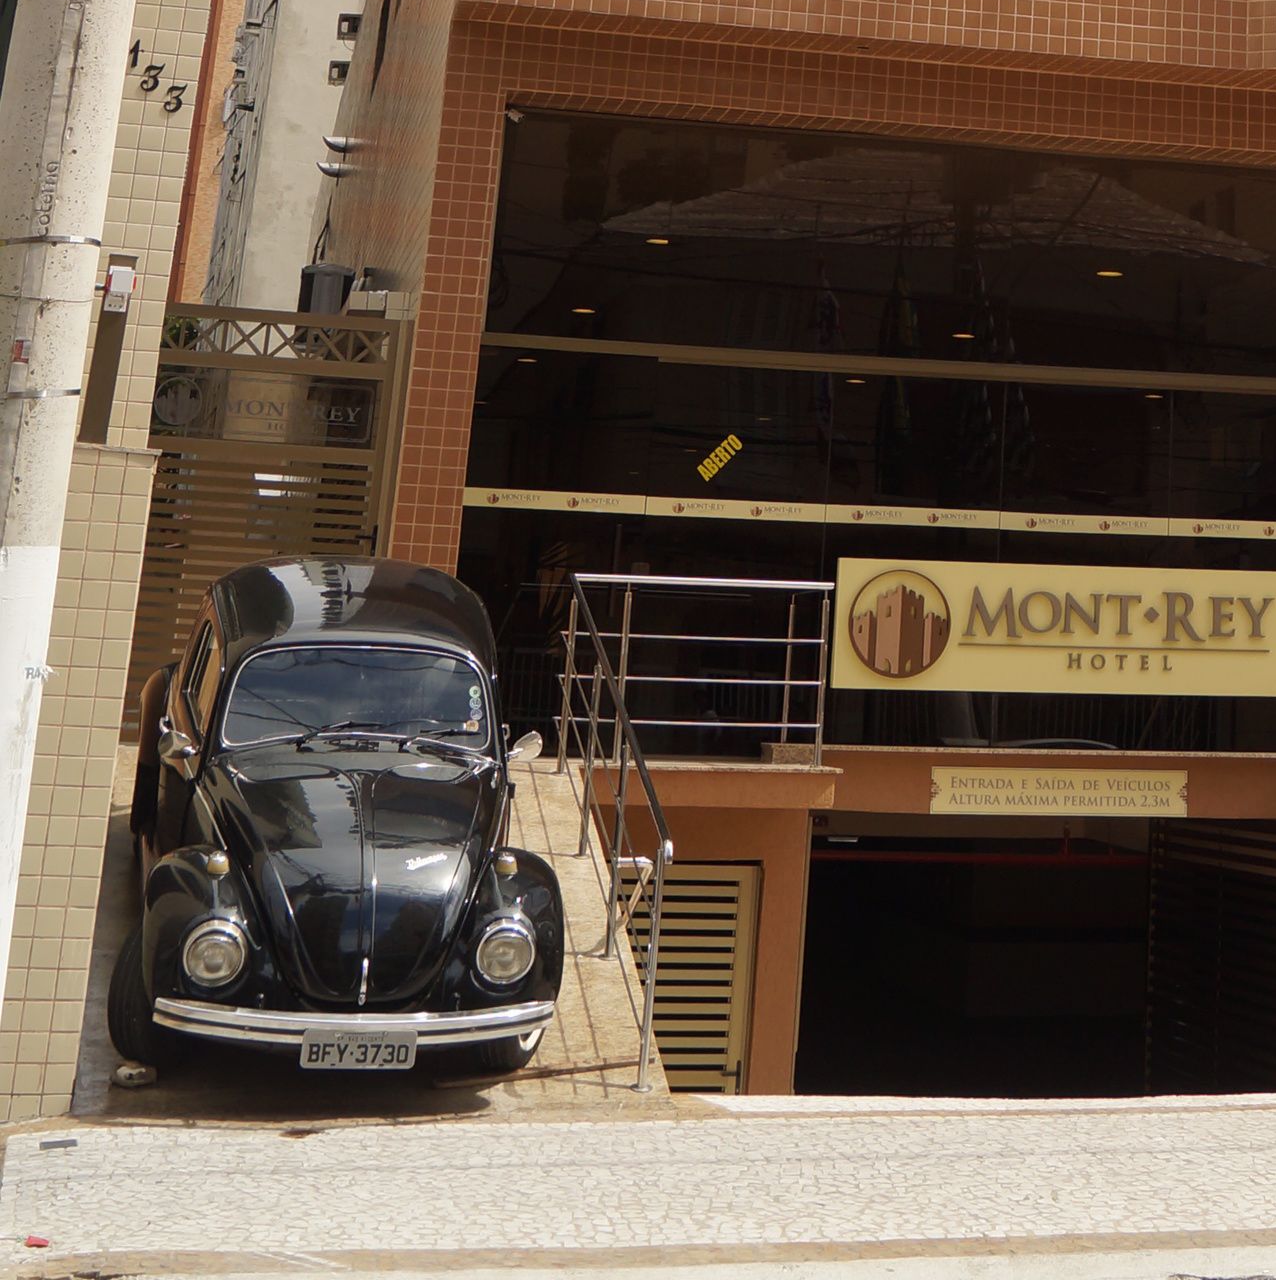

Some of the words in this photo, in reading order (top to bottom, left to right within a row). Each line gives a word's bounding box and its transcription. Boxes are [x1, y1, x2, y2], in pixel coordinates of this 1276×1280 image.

[129, 39, 188, 113] 133
[697, 434, 743, 482] ABERTO
[1067, 653, 1173, 672] HOTEL
[950, 776, 1014, 790] ENTRADA
[1021, 779, 1028, 790] E
[1035, 776, 1075, 791] SAÍDA
[1083, 779, 1100, 791] DE
[1106, 778, 1171, 792] VEÍCULOS
[949, 792, 1000, 807] ALTURA
[1005, 792, 1059, 808] MÁXIMA
[1063, 795, 1137, 808] PERMITIDA
